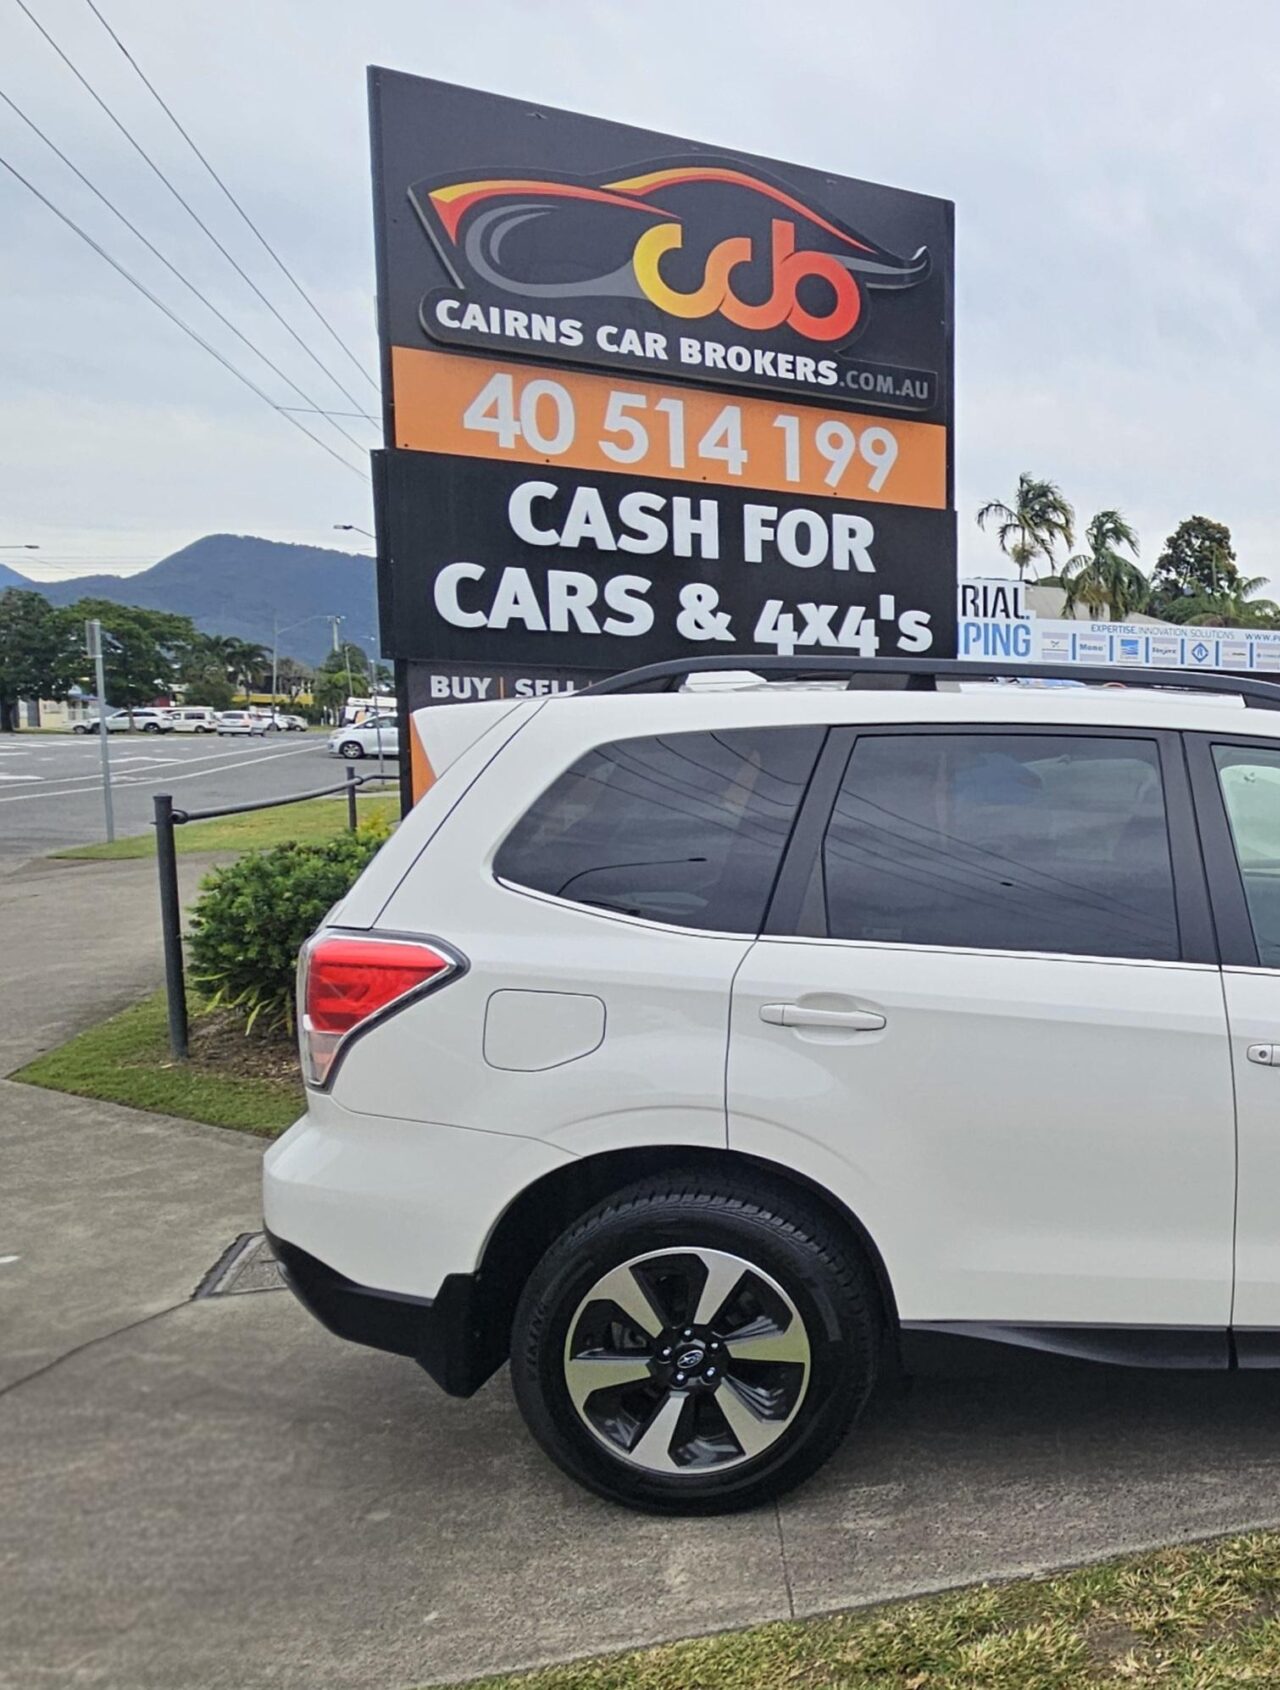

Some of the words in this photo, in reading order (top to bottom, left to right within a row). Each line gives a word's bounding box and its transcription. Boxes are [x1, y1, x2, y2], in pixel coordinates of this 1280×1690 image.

[435, 298, 584, 347] CAIRNS
[596, 325, 669, 361] CAR
[463, 373, 575, 455] 40
[599, 390, 748, 476] 514
[773, 414, 898, 493] 199
[508, 480, 719, 560] CASH
[744, 503, 876, 573] FOR
[433, 562, 655, 638] CARS
[676, 583, 736, 642] &
[430, 675, 492, 700] BUY
